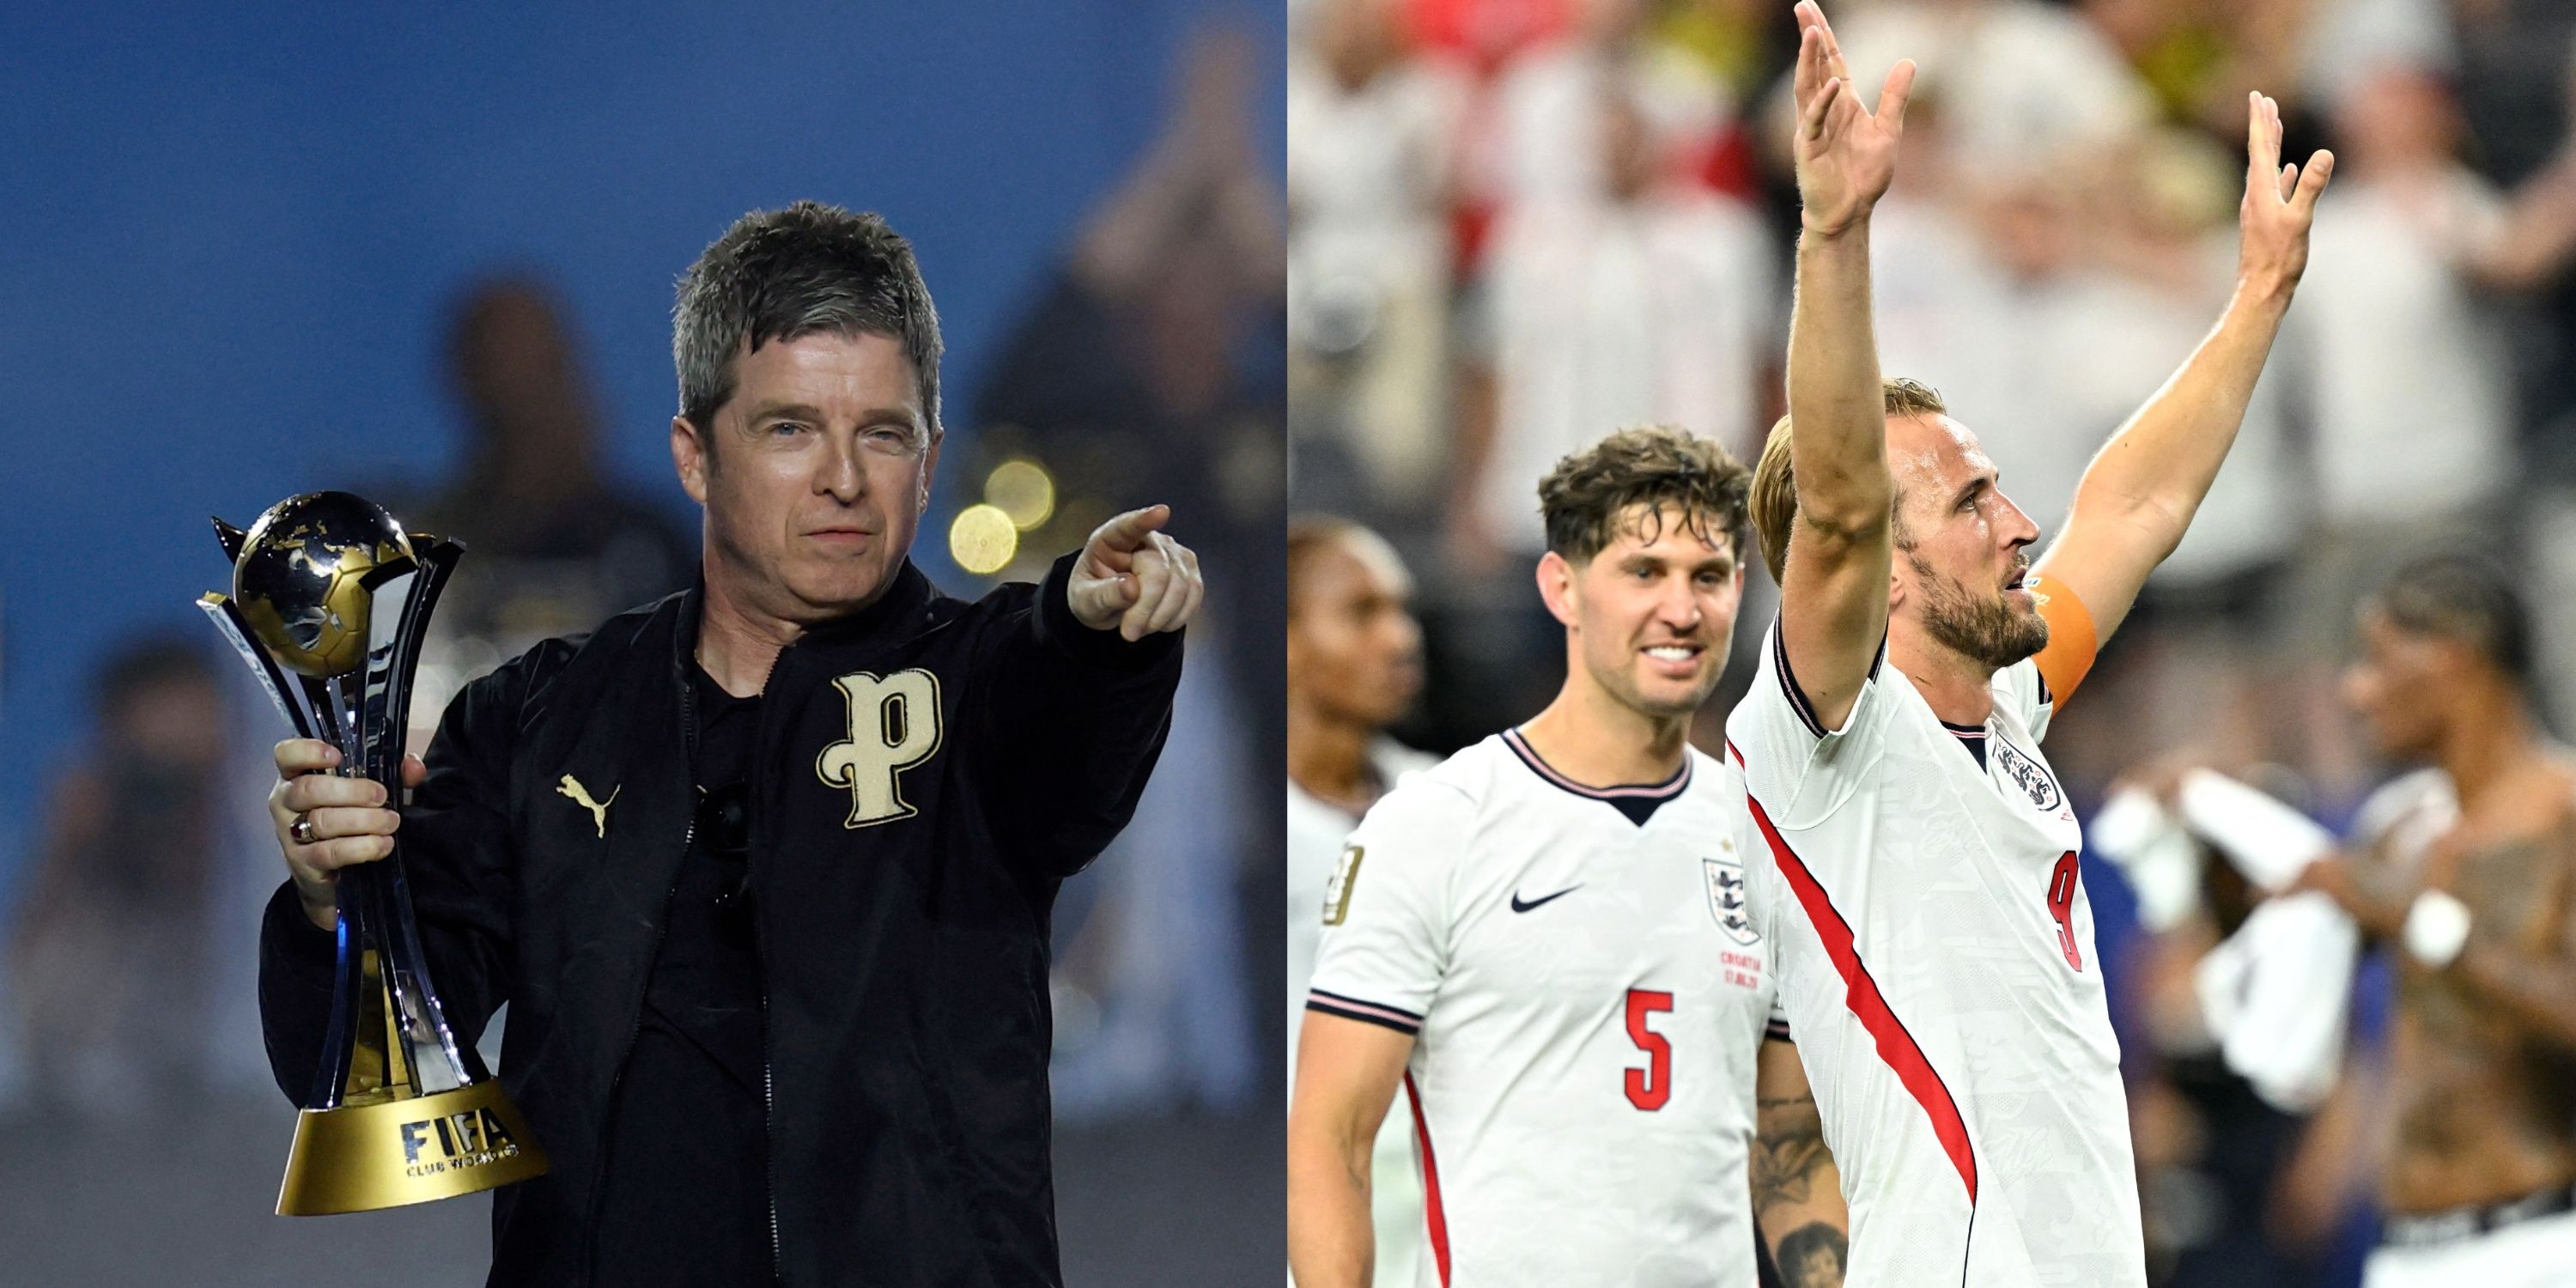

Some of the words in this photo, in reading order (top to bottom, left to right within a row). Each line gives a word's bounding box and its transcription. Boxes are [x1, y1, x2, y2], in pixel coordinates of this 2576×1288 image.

[2047, 850, 2082, 972] 9
[1625, 989, 1674, 1111] 5
[400, 1107, 515, 1164] FIFA
[406, 1161, 446, 1177] CLUB
